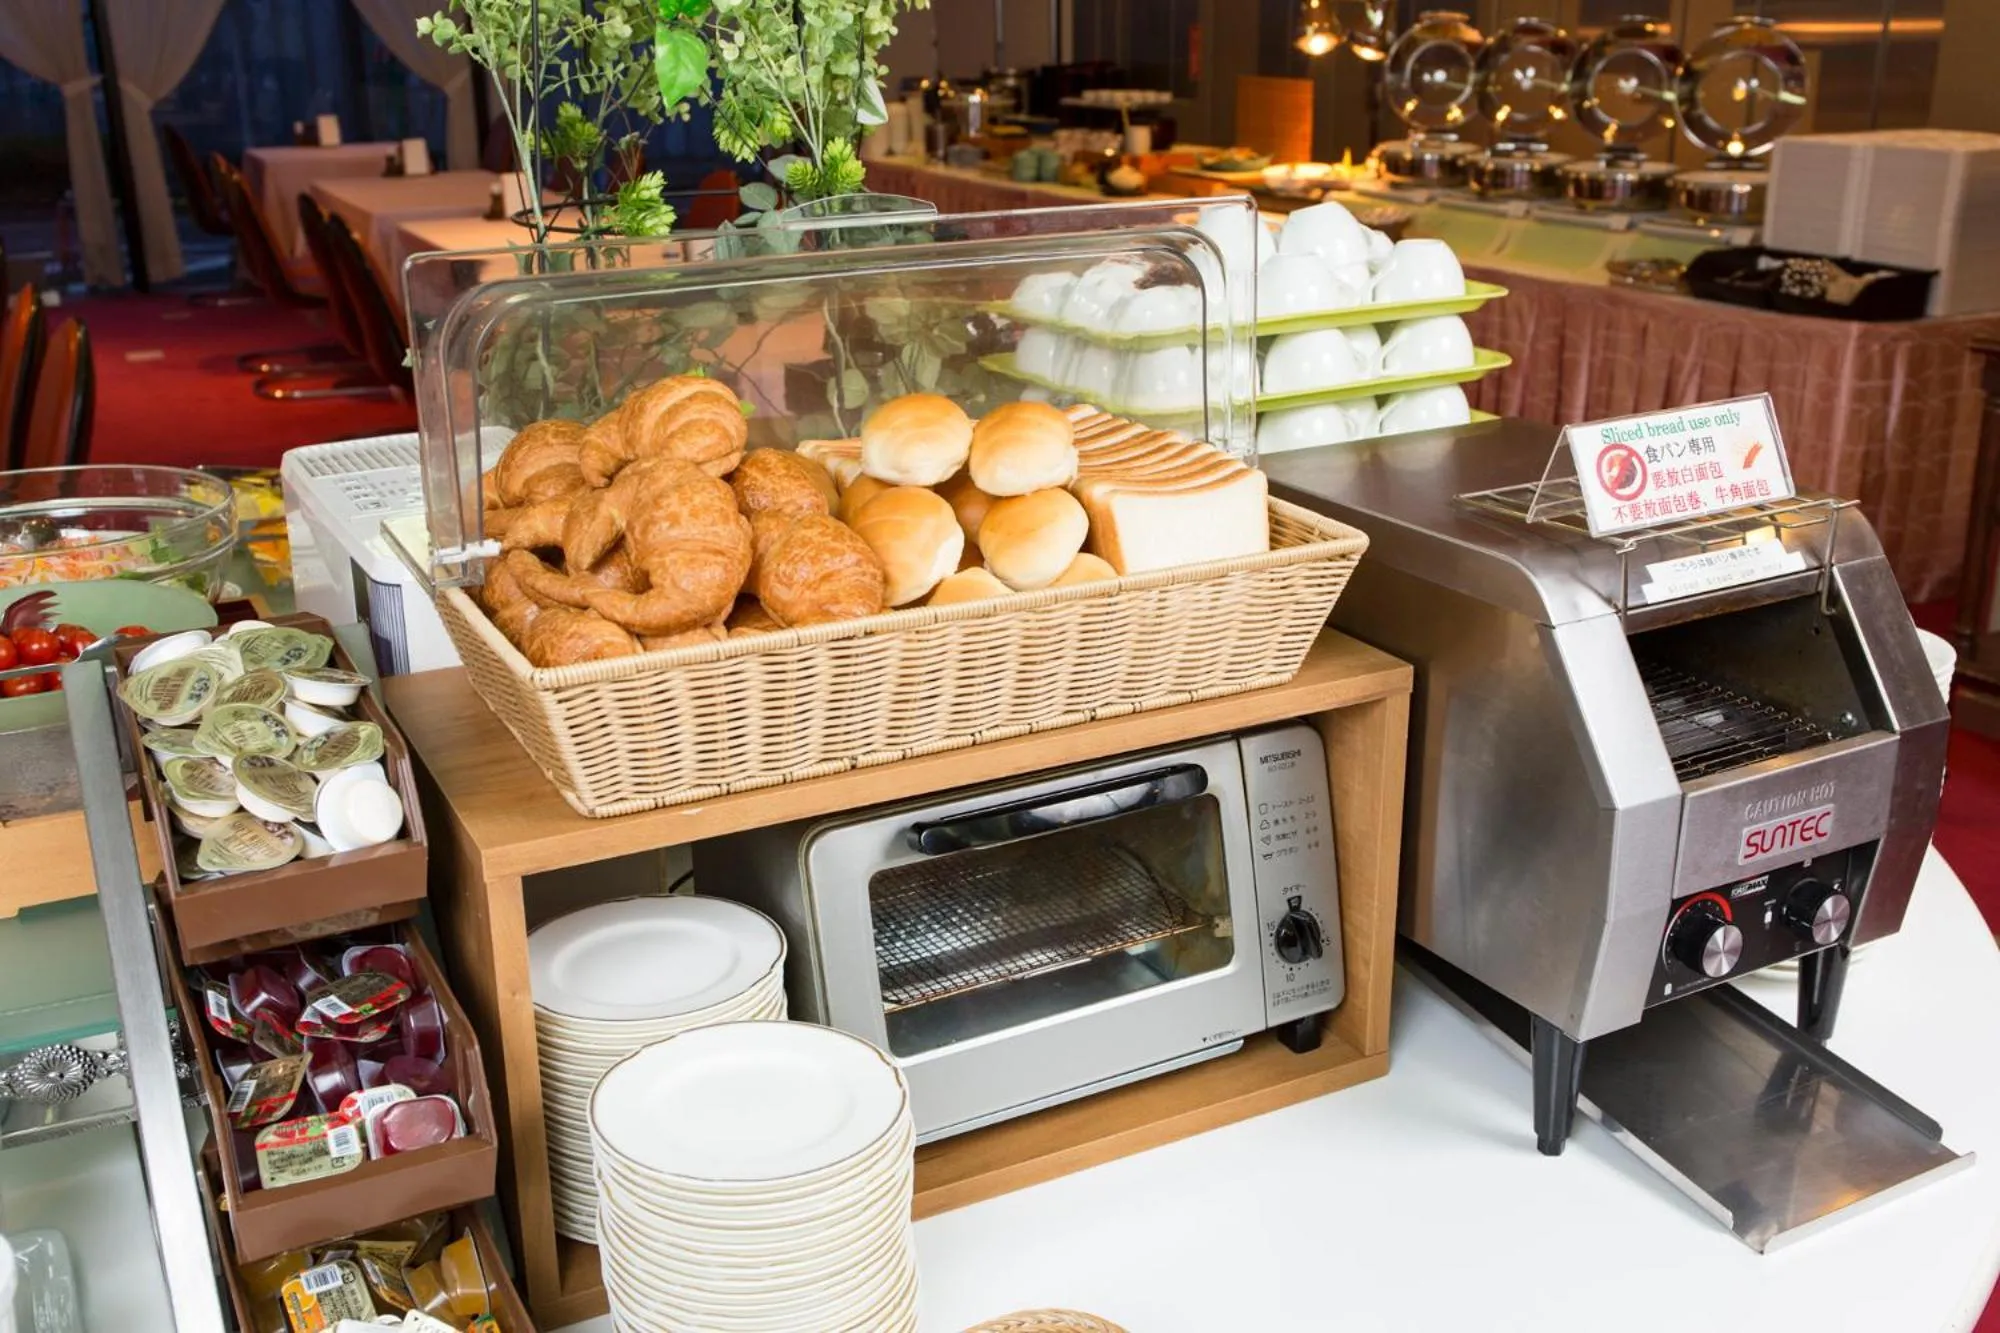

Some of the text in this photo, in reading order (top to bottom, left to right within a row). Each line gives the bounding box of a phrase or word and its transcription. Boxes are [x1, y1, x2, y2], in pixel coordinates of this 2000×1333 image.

[1600, 408, 1741, 444] Sliced bread use only
[1644, 436, 1717, 464] 食パン専用
[1743, 811, 1832, 859] SUNTEC
[1266, 920, 1276, 931] 15
[1285, 972, 1296, 983] 10
